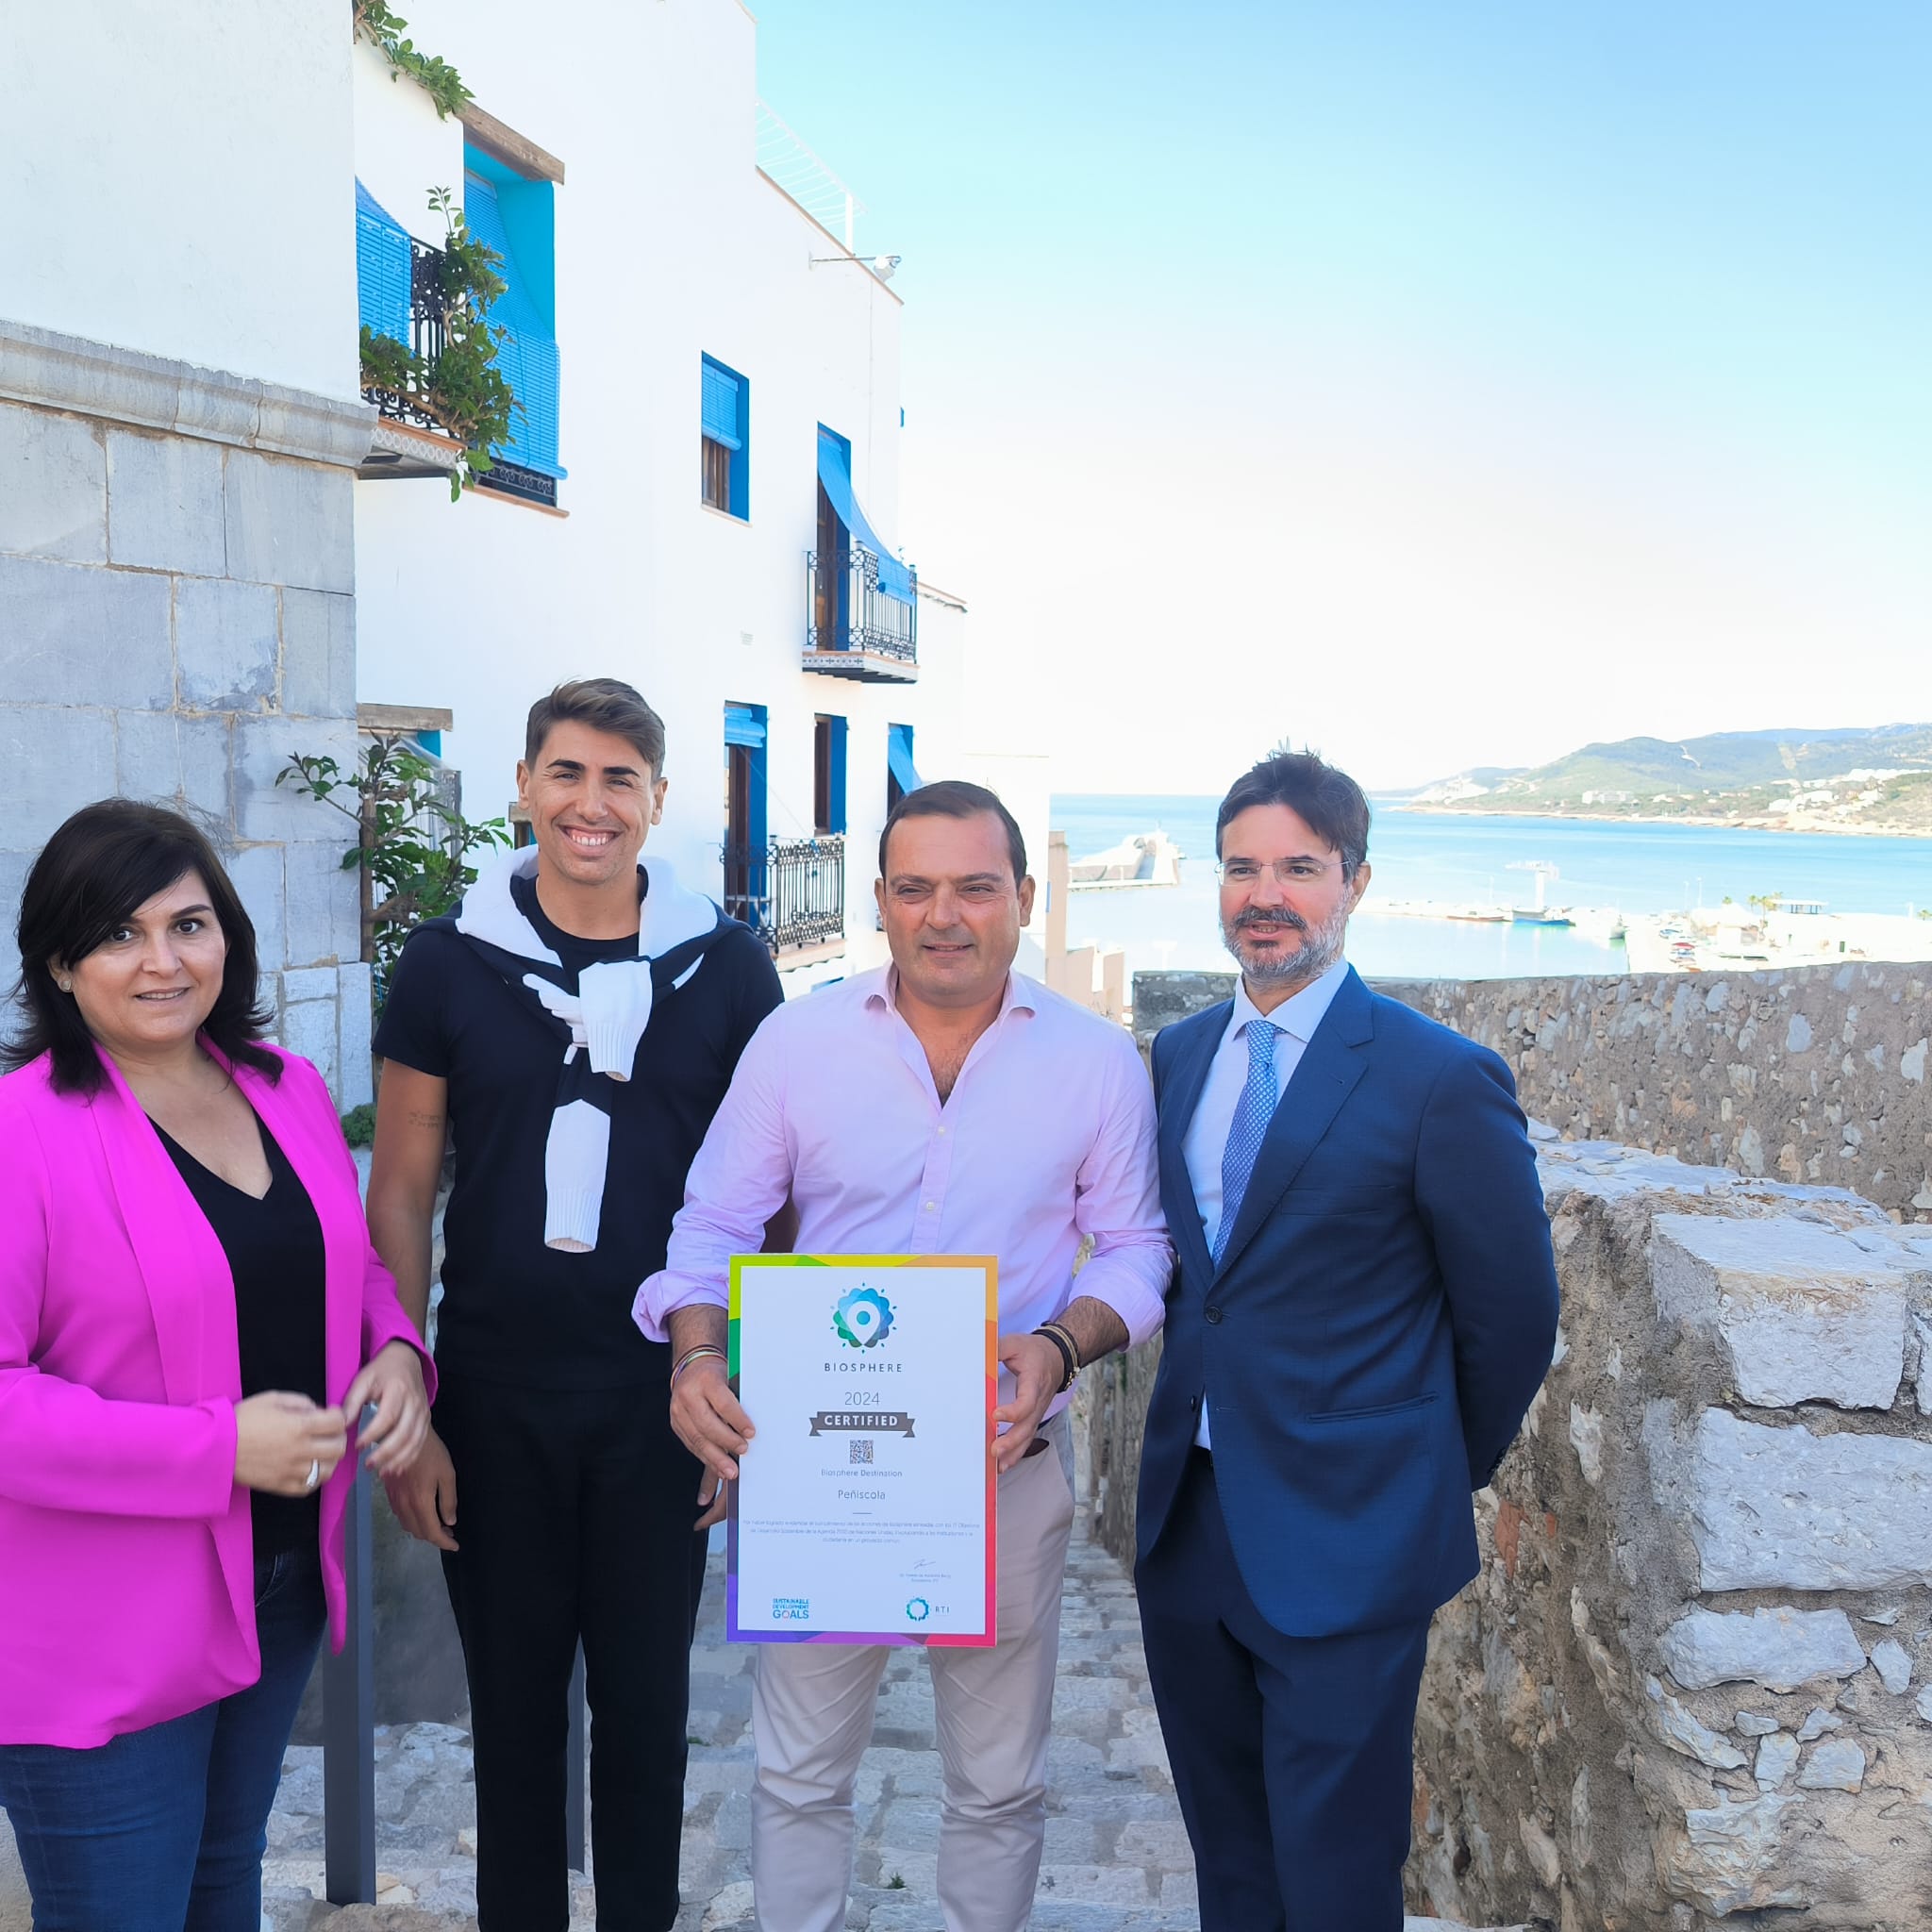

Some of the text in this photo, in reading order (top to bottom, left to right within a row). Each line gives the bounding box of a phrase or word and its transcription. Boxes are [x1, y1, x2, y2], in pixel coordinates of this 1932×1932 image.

[824, 1362, 902, 1373] BIOSPHERE
[844, 1391, 880, 1406] 2024
[824, 1414, 898, 1426] CERTIFIED
[821, 1468, 903, 1478] Biosphere Destination
[838, 1489, 886, 1500] Peñiscola
[773, 1609, 809, 1620] GOALS
